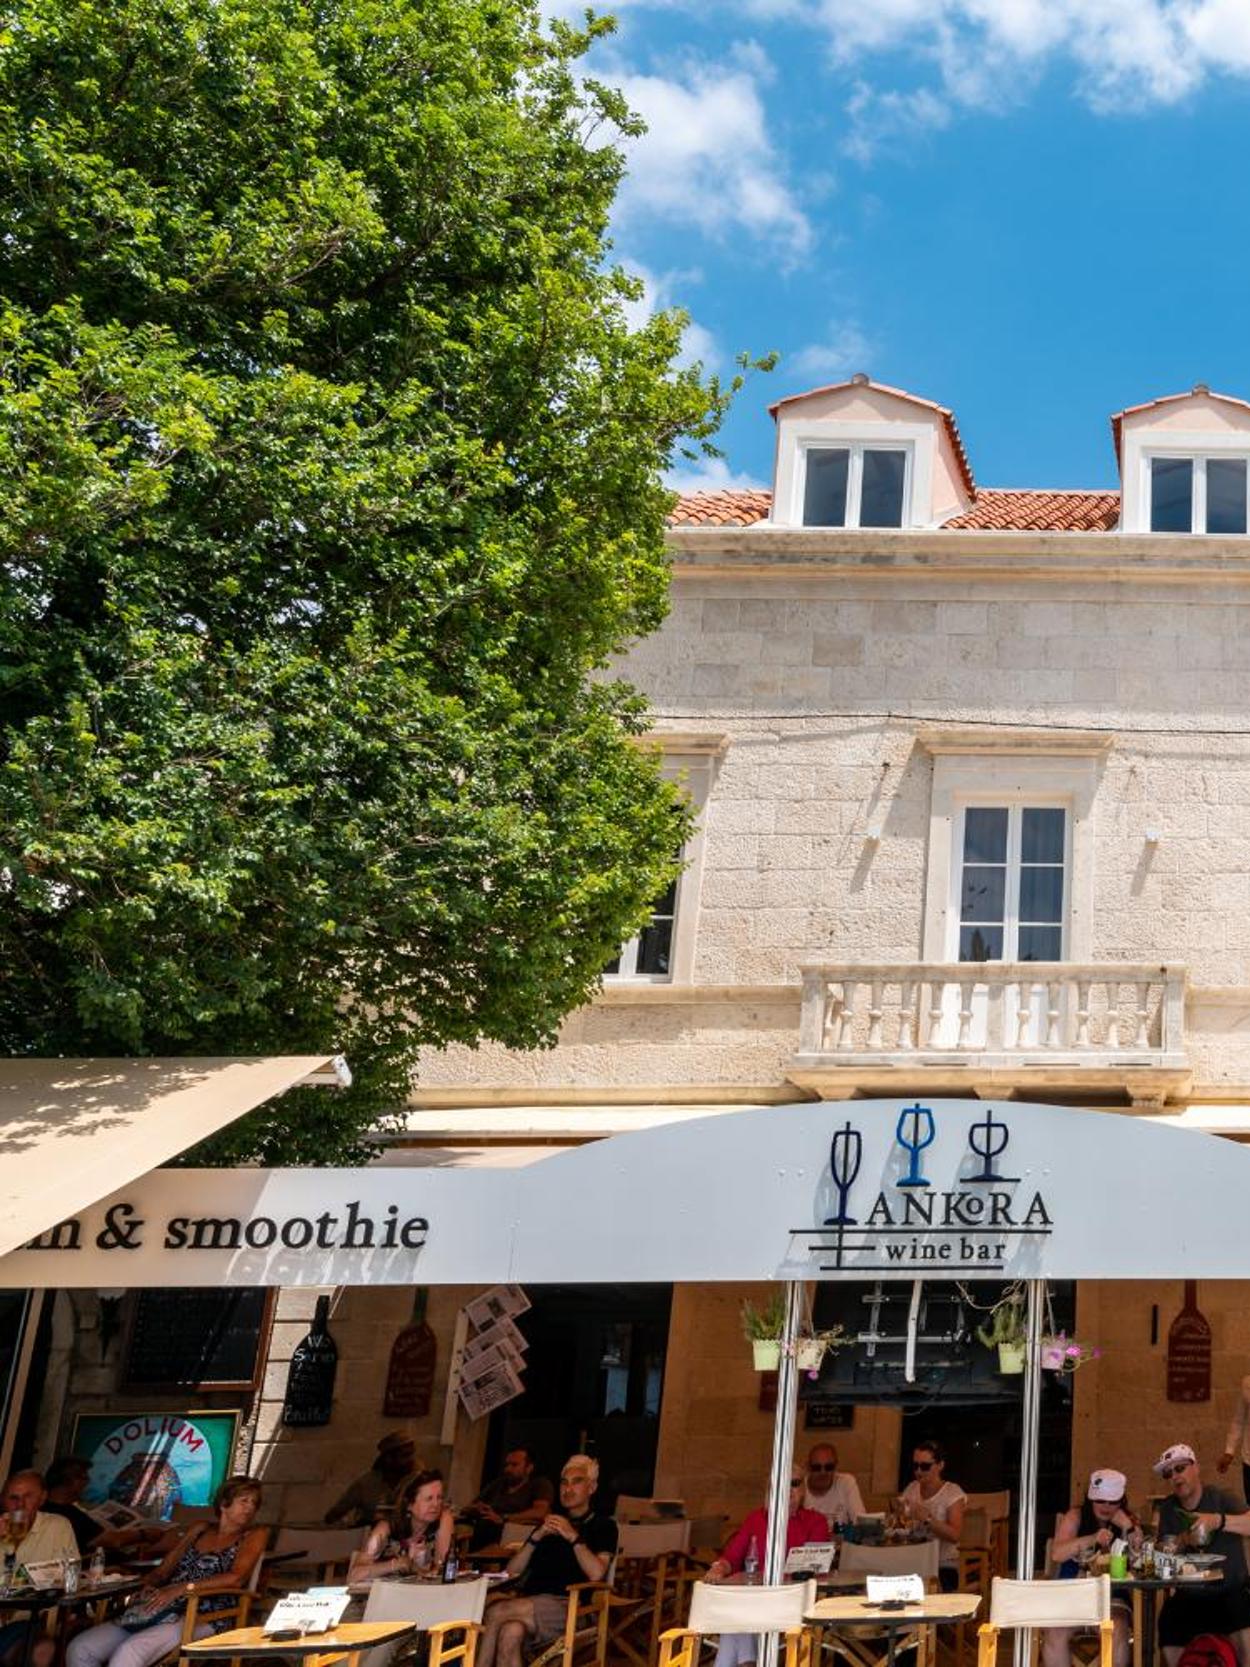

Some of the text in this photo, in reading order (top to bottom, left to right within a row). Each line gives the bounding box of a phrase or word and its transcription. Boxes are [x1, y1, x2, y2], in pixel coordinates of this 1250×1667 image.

[96, 1203, 145, 1249] &
[164, 1202, 430, 1249] smoothie
[885, 1237, 1006, 1260] wine bar
[104, 1416, 204, 1455] DOLIUM
